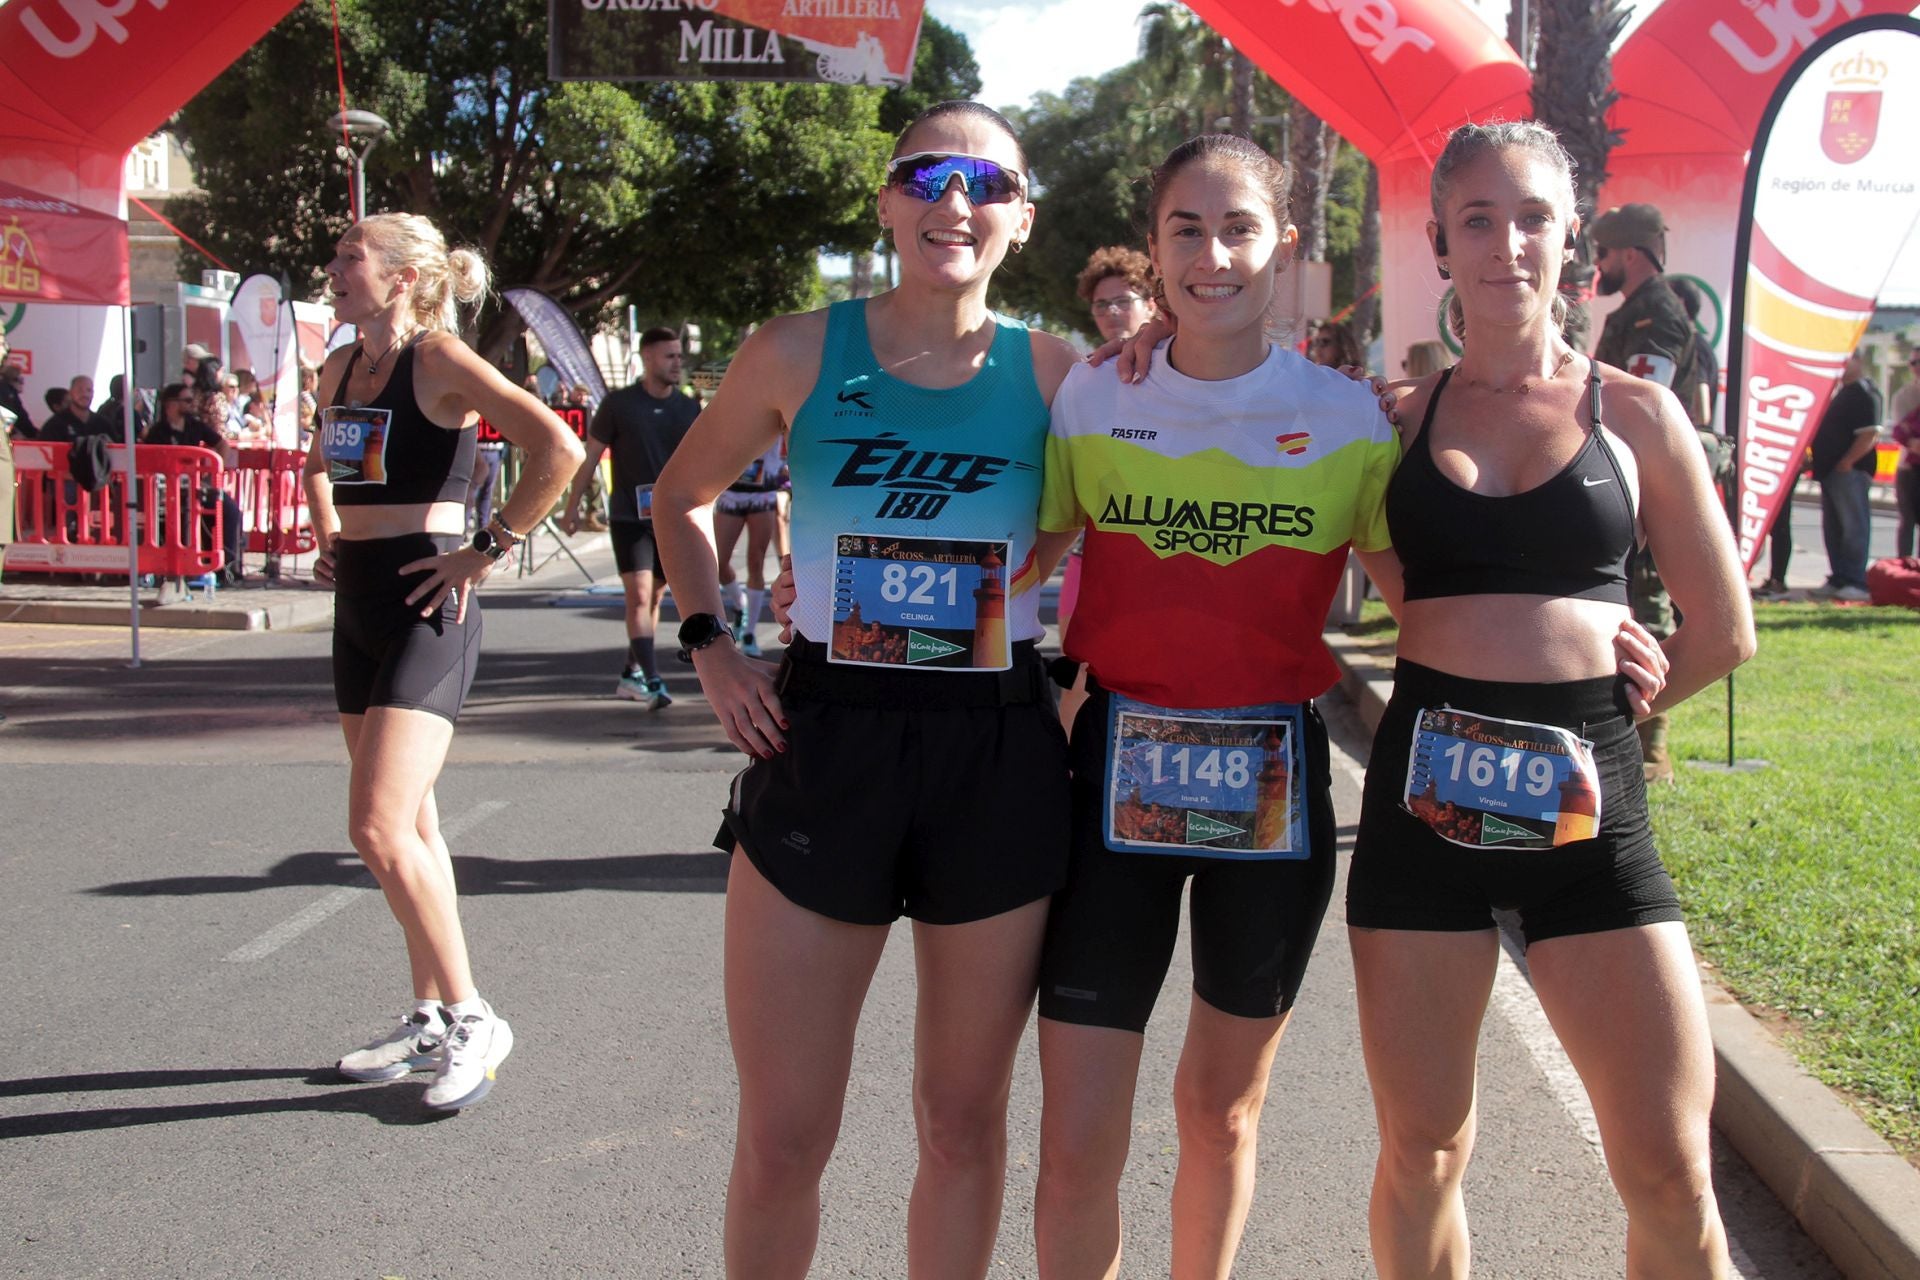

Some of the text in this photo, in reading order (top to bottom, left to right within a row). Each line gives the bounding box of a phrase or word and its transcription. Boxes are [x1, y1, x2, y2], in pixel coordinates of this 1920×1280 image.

[678, 19, 785, 64] MILLA
[1831, 179, 1851, 192] de
[1857, 179, 1915, 193] Murcia
[322, 423, 362, 447] 1059
[1110, 428, 1158, 441] FASTER
[1739, 375, 1816, 563] DEPORTES
[875, 491, 951, 521] 180
[1099, 494, 1316, 537] ALUMBRES
[1153, 529, 1250, 556] SPORT
[892, 550, 924, 561] CROSS
[933, 553, 977, 564] ARTILLERÍA
[880, 563, 957, 606] 821
[900, 612, 935, 622] CELINGA
[1169, 735, 1201, 744] CROSS
[1472, 732, 1504, 744] CROSS
[1511, 739, 1566, 755] ARTILLERÍA
[1145, 745, 1250, 789] 1148
[1444, 742, 1554, 797] 1619
[1200, 795, 1210, 803] PL
[1479, 796, 1508, 808] Virginia
